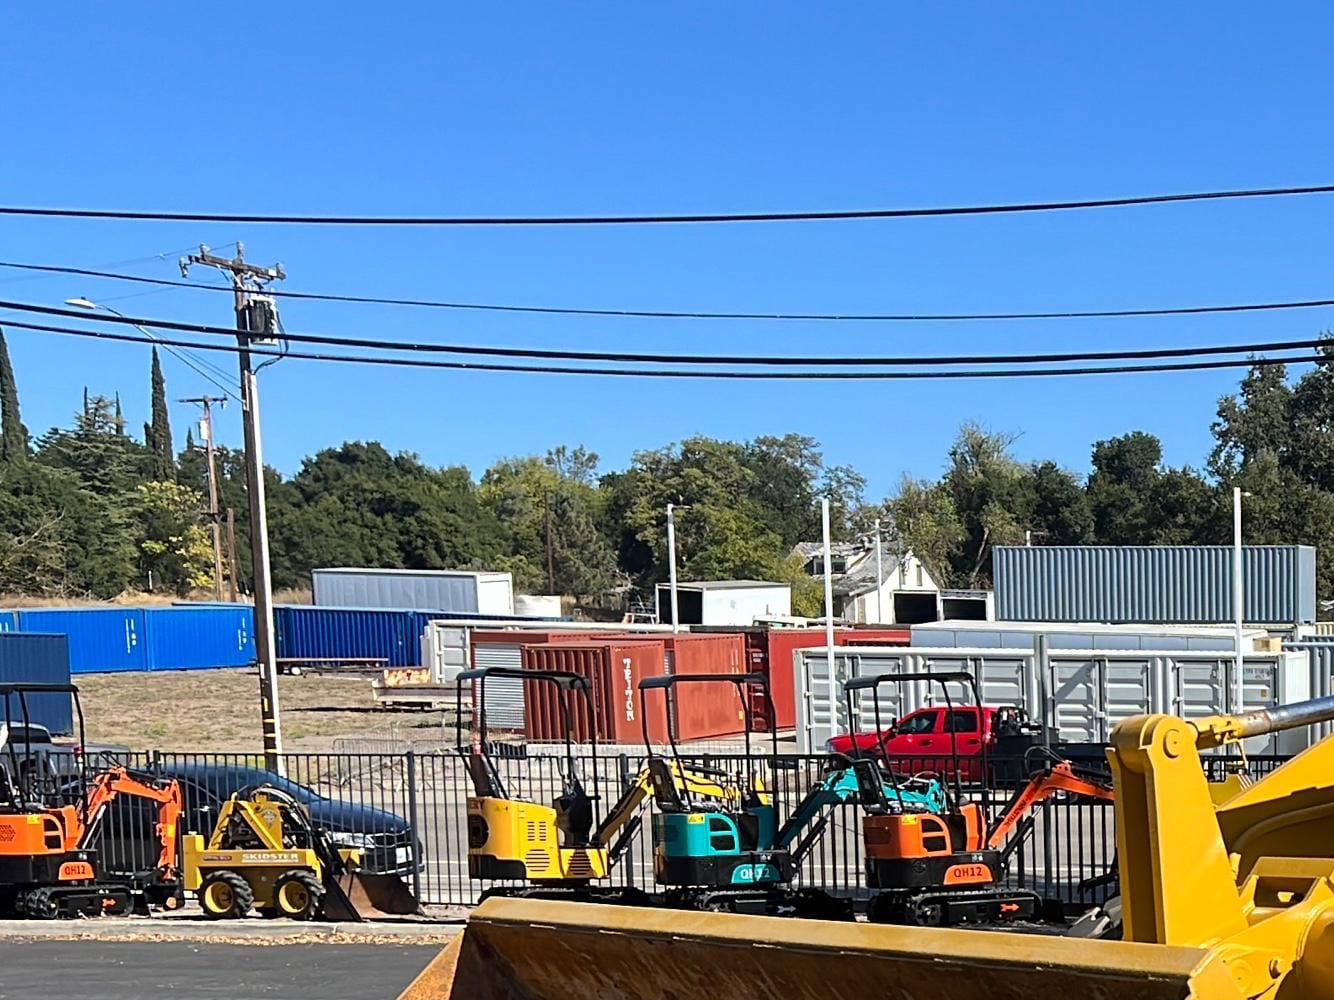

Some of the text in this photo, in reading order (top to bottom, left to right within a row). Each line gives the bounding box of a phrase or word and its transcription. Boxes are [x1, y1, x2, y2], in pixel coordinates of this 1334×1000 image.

[623, 658, 635, 721] TRITON
[241, 853, 299, 861] SKIDSTER
[953, 866, 983, 878] QH12
